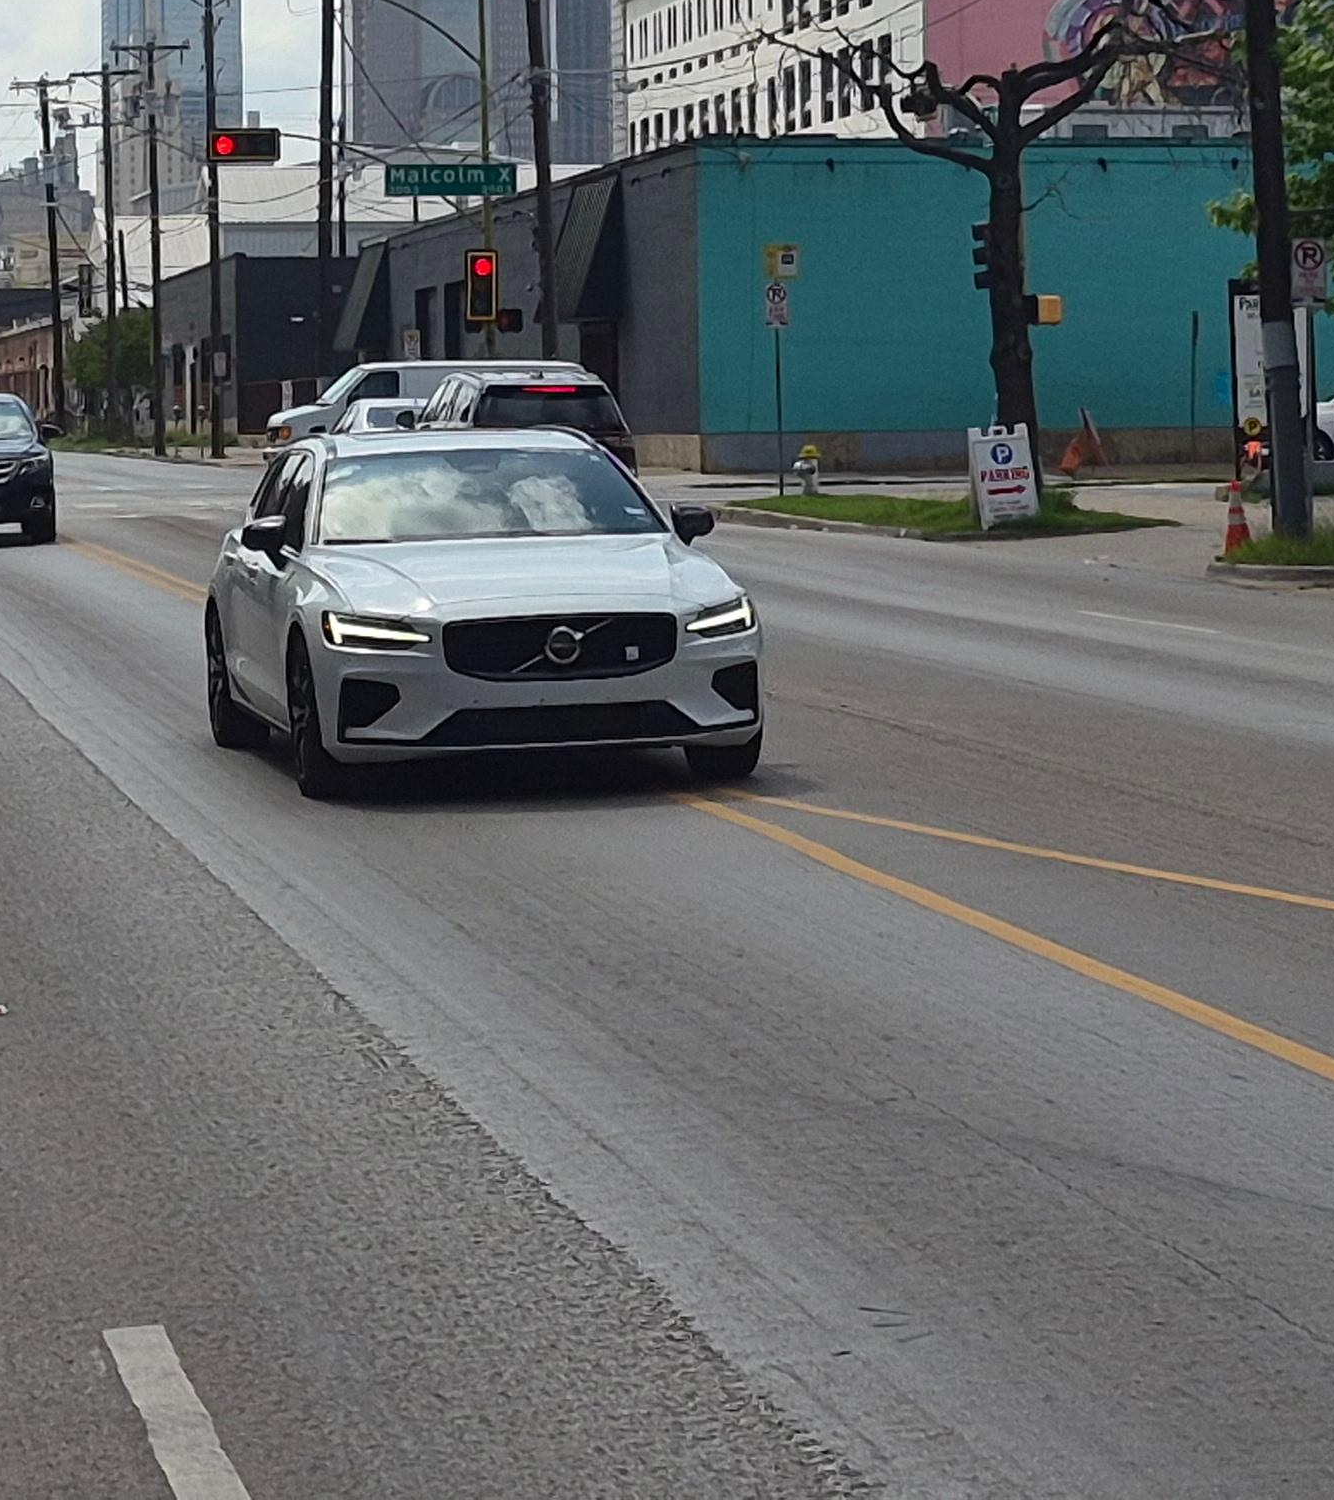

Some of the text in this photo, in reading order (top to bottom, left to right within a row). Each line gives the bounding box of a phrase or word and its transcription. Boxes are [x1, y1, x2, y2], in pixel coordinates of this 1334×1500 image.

[390, 167, 510, 184] Malcolm X
[996, 446, 1010, 463] P
[980, 466, 1030, 483] PARKING
